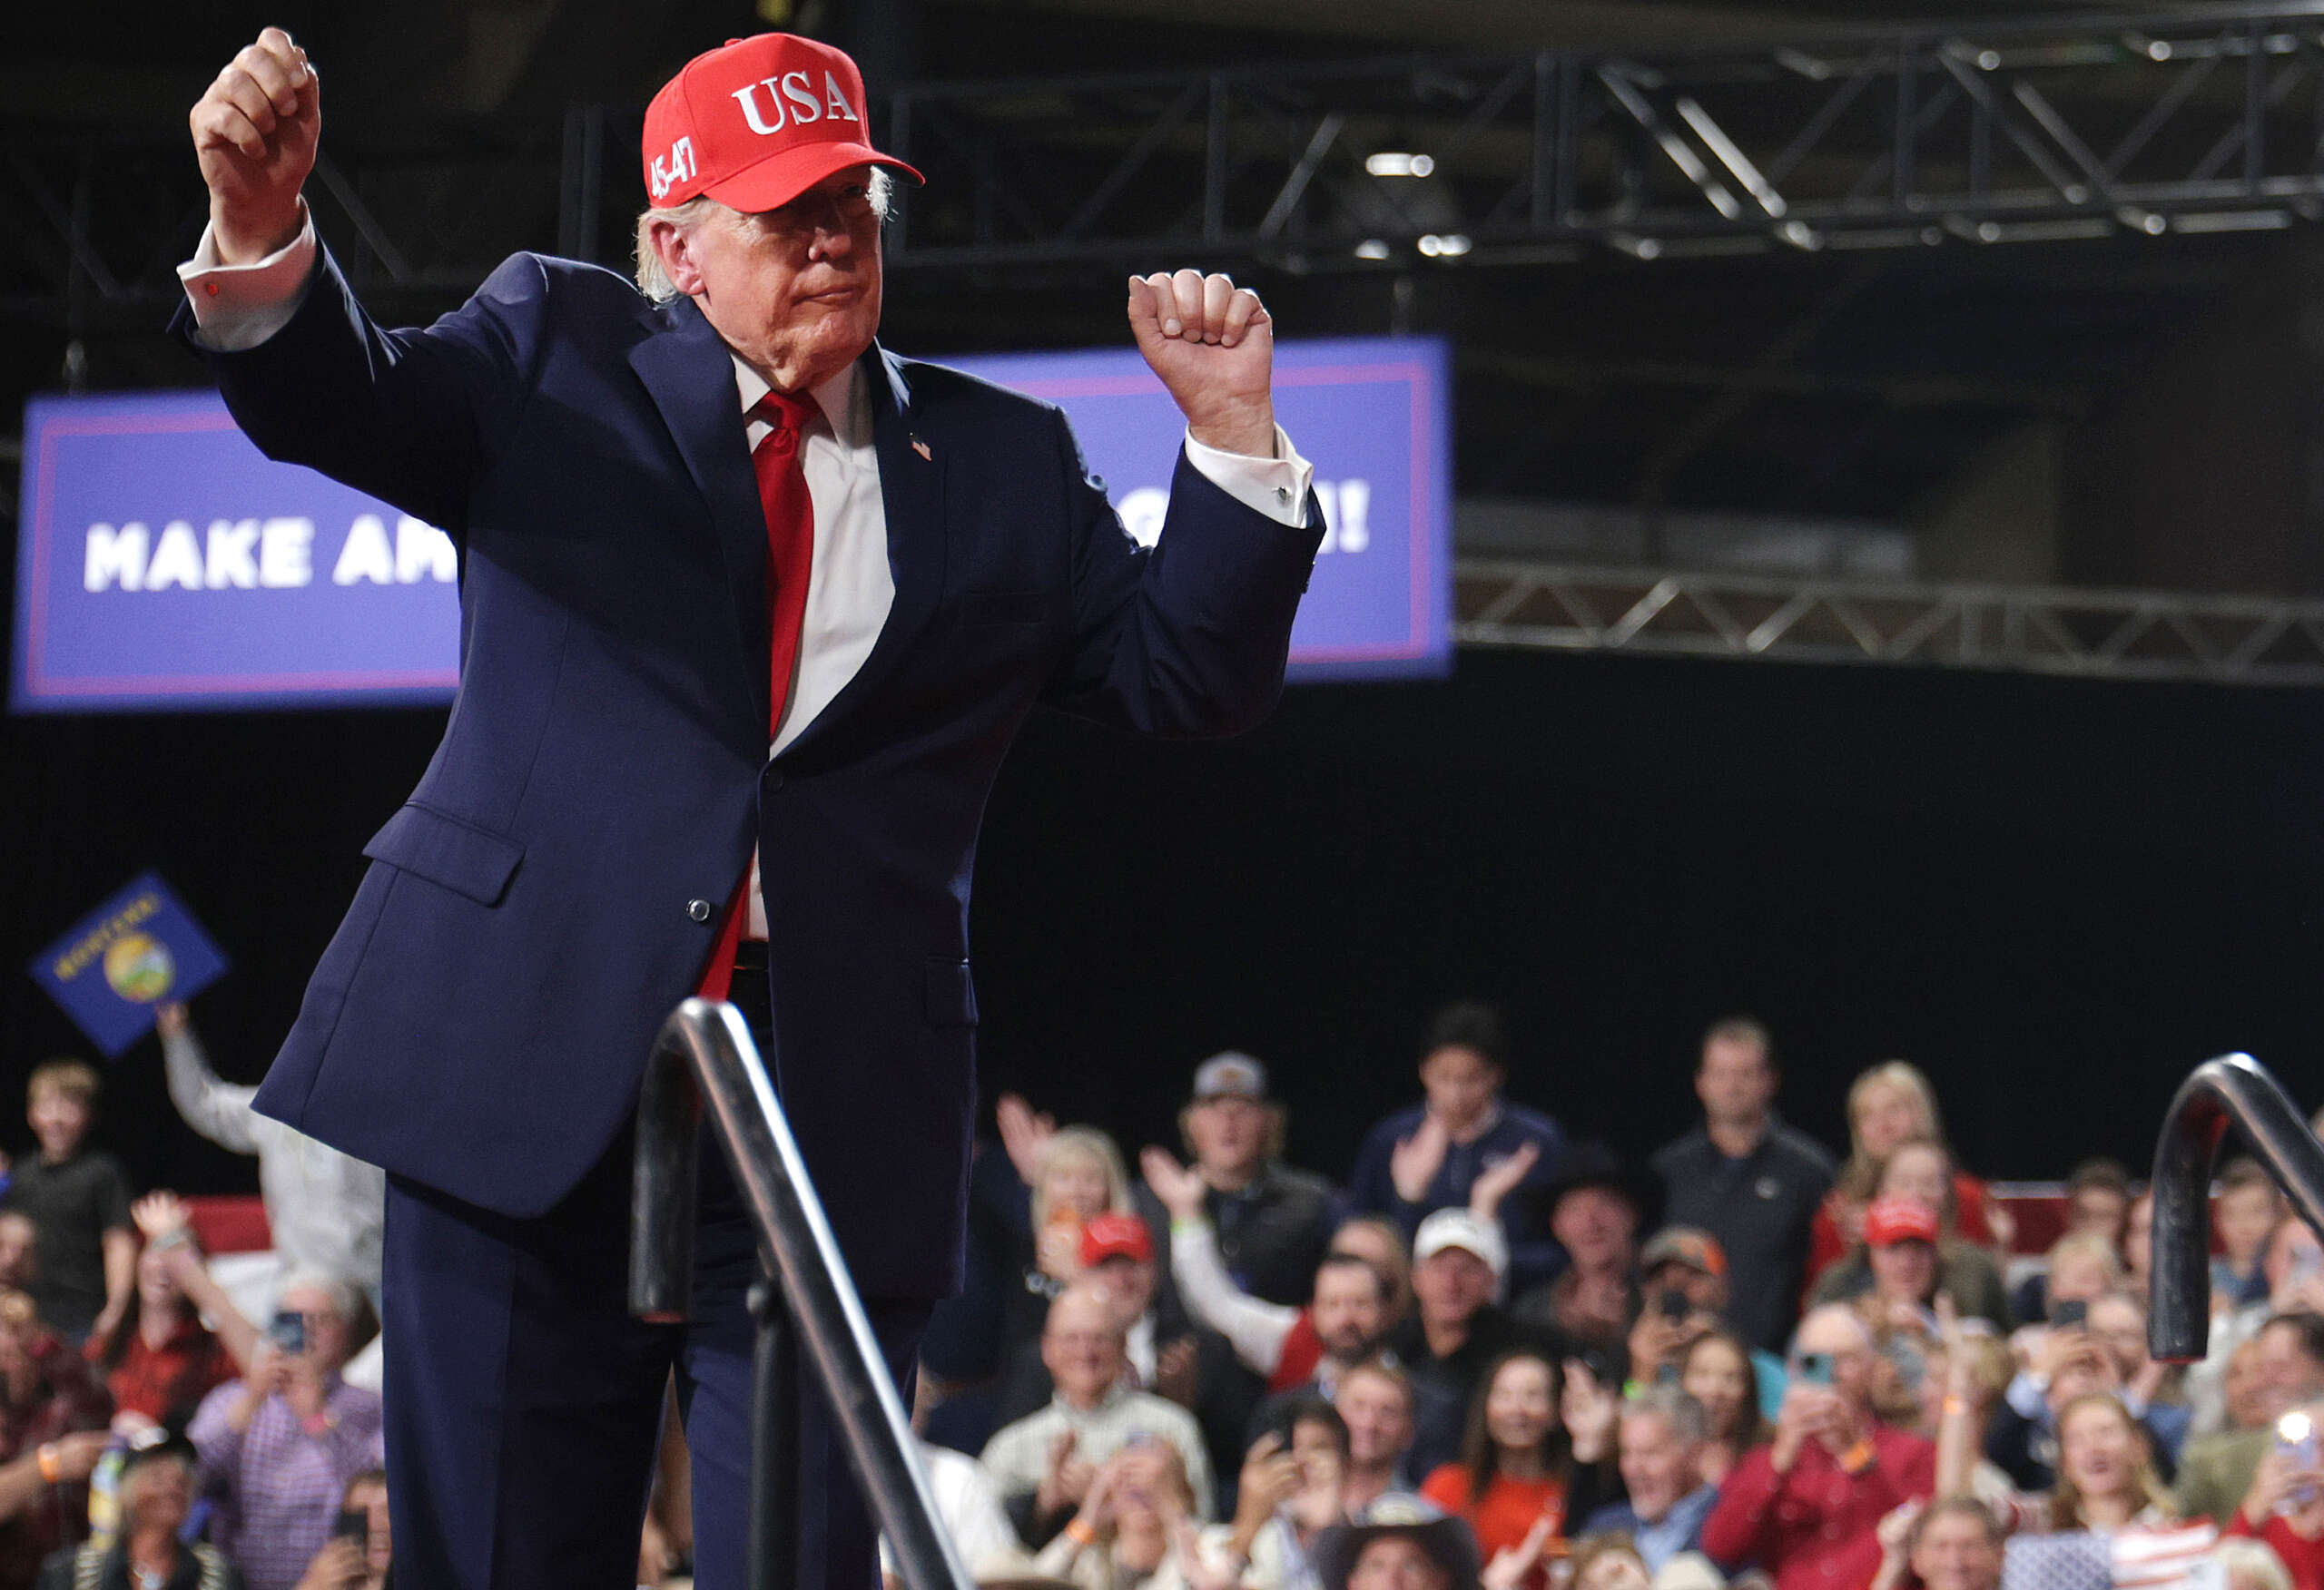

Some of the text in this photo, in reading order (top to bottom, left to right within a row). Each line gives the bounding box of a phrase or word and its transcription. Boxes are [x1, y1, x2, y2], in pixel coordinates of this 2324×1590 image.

[732, 70, 858, 135] USA
[651, 136, 697, 199] 45-47
[84, 515, 458, 593] MAKE AM
